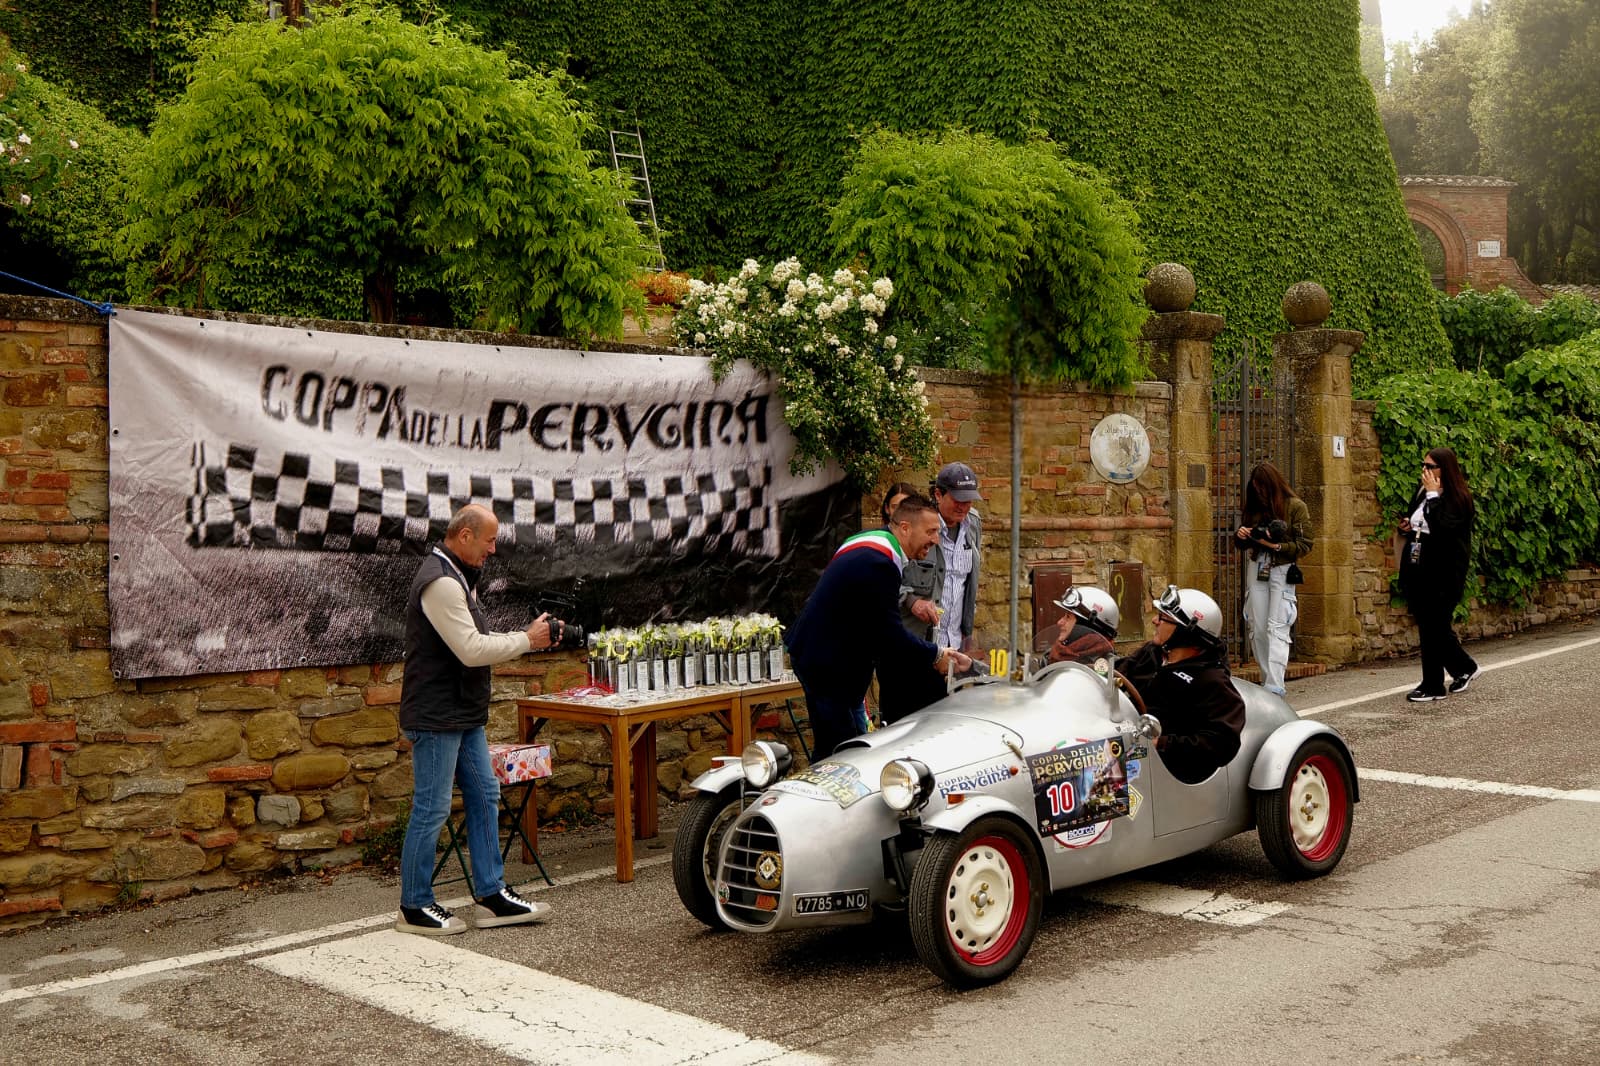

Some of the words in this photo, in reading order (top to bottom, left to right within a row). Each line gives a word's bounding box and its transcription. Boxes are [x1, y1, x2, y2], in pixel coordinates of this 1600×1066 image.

[260, 364, 408, 440] COPPA
[410, 409, 483, 451] DELLA
[989, 648, 1008, 678] 10
[1032, 753, 1066, 767] COPPA
[1071, 745, 1104, 757] DELLA
[937, 774, 970, 788] COPPA
[976, 763, 1008, 776] DELLA
[1047, 782, 1075, 816] 10
[797, 897, 832, 912] 47785
[846, 894, 865, 908] NO
